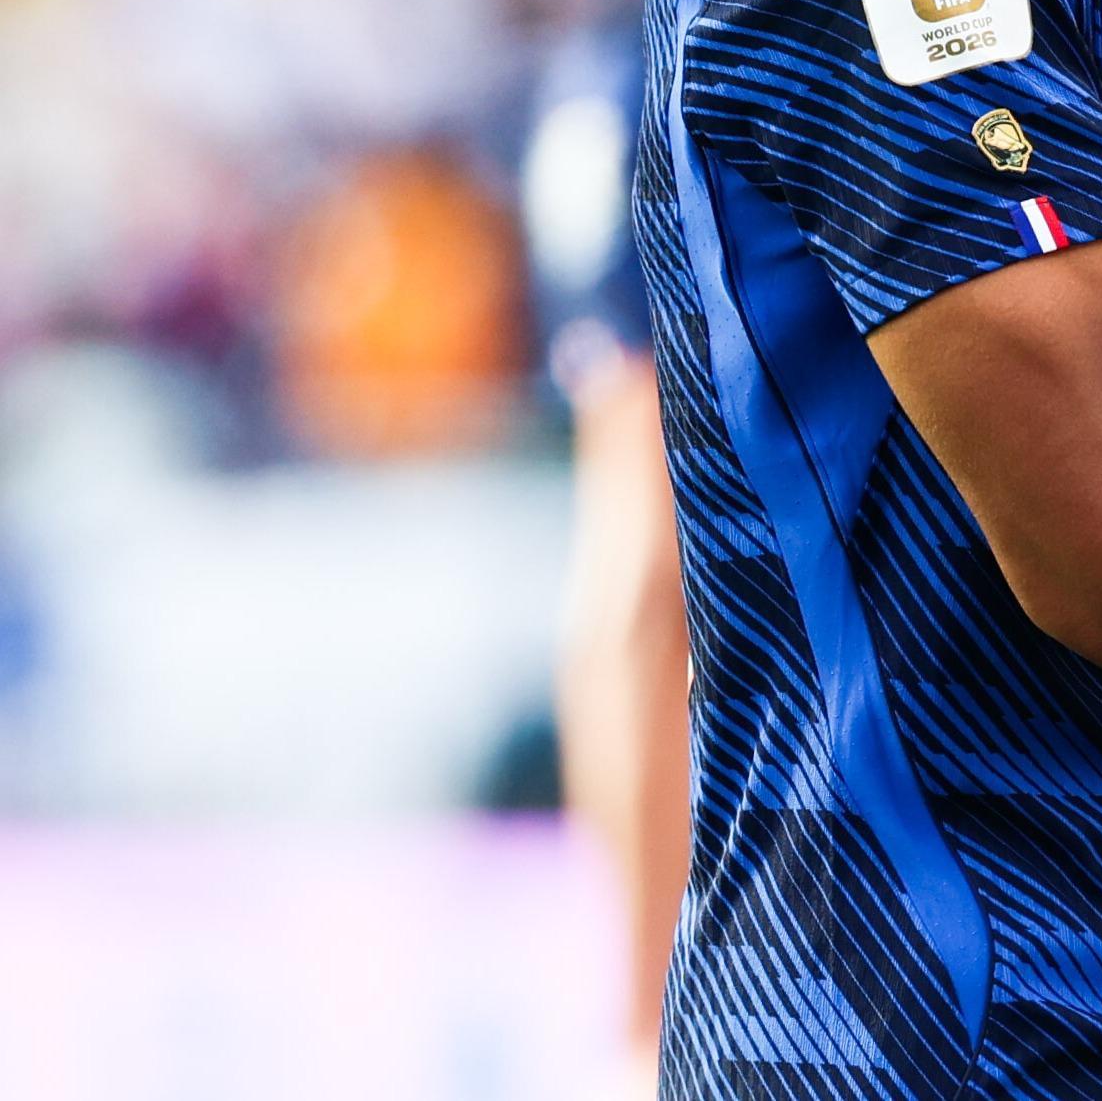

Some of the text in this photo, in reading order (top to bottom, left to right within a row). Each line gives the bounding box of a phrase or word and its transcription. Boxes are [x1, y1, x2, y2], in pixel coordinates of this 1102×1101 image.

[921, 16, 993, 43] WORLD CUP
[926, 30, 997, 62] 2026
